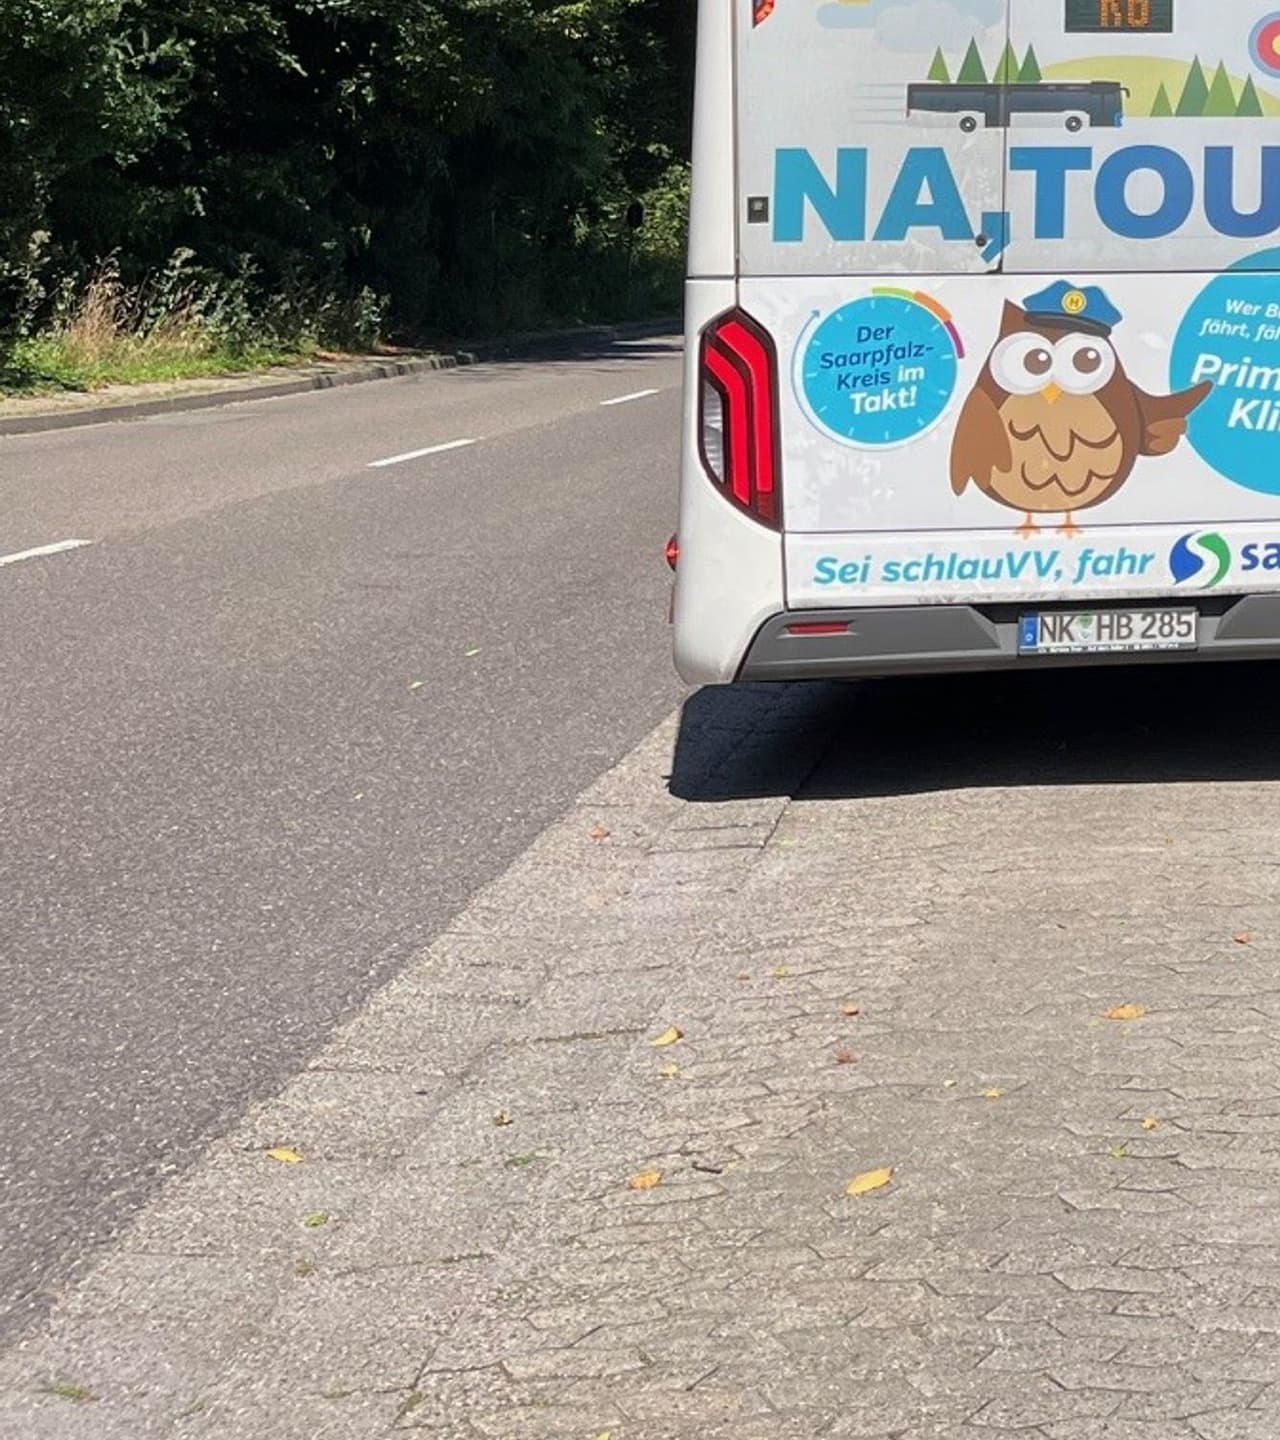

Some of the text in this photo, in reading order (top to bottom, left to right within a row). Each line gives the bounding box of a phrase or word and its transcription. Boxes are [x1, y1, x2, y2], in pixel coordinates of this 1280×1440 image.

[1225, 299, 1261, 315] Wer
[857, 325, 895, 343] Der
[1199, 318, 1250, 338] fährt,
[820, 341, 934, 369] Saarpfalz-
[837, 365, 925, 391] Kreis im
[850, 386, 917, 414] Takt!
[813, 547, 1155, 584] Sei schlauVV, fahr
[1040, 612, 1193, 643] NK HB 285
